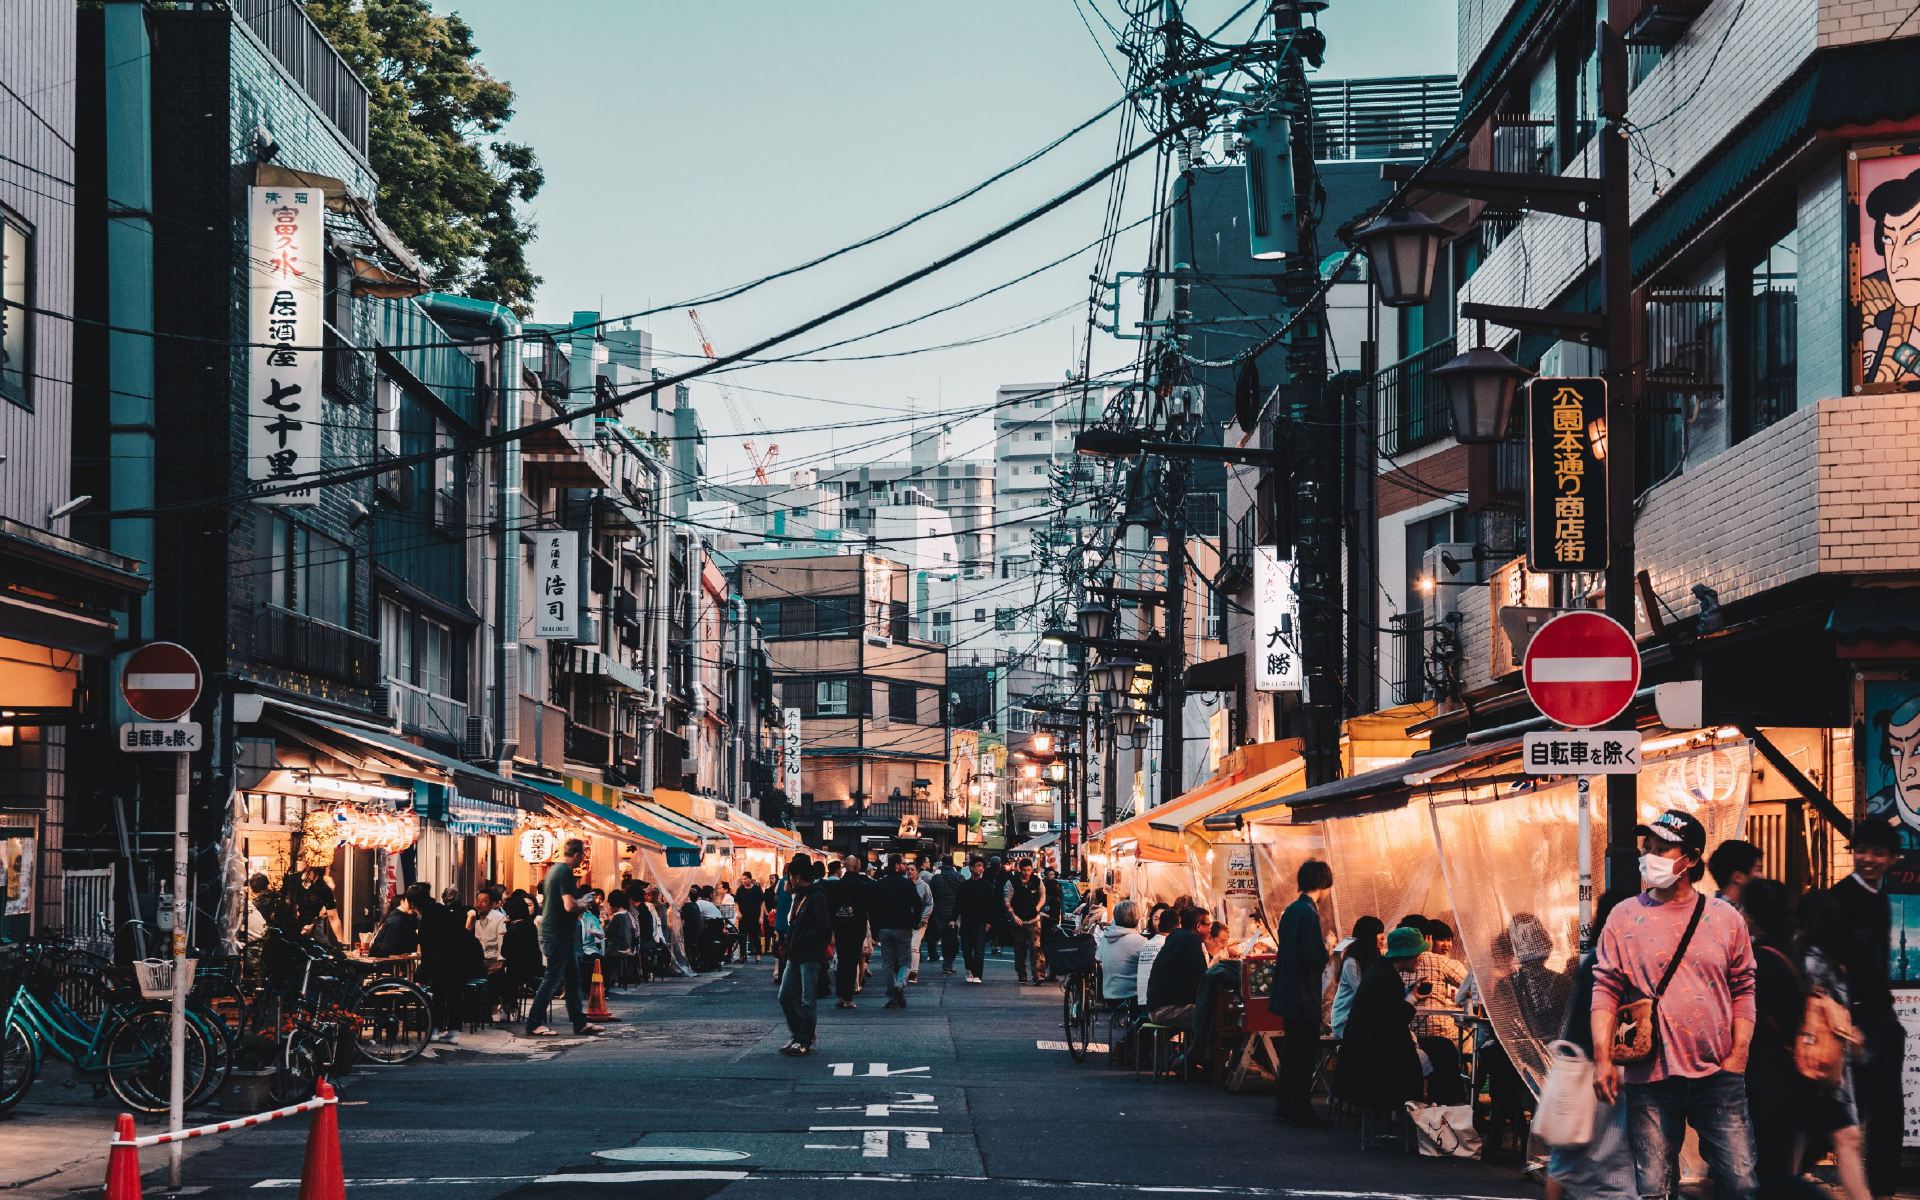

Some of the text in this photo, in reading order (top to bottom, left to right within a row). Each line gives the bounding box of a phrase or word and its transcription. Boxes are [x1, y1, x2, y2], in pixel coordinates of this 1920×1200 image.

[266, 290, 298, 367] 居酒屋
[262, 378, 302, 480] 七十里
[1552, 386, 1585, 563] 公園本通り商店街
[545, 538, 567, 621] 居酒屋 浩司
[1266, 626, 1291, 675] 大勝
[127, 729, 195, 747] 自転車を除く
[1531, 741, 1636, 766] 自転車を除く
[1227, 879, 1256, 889] 受賞店
